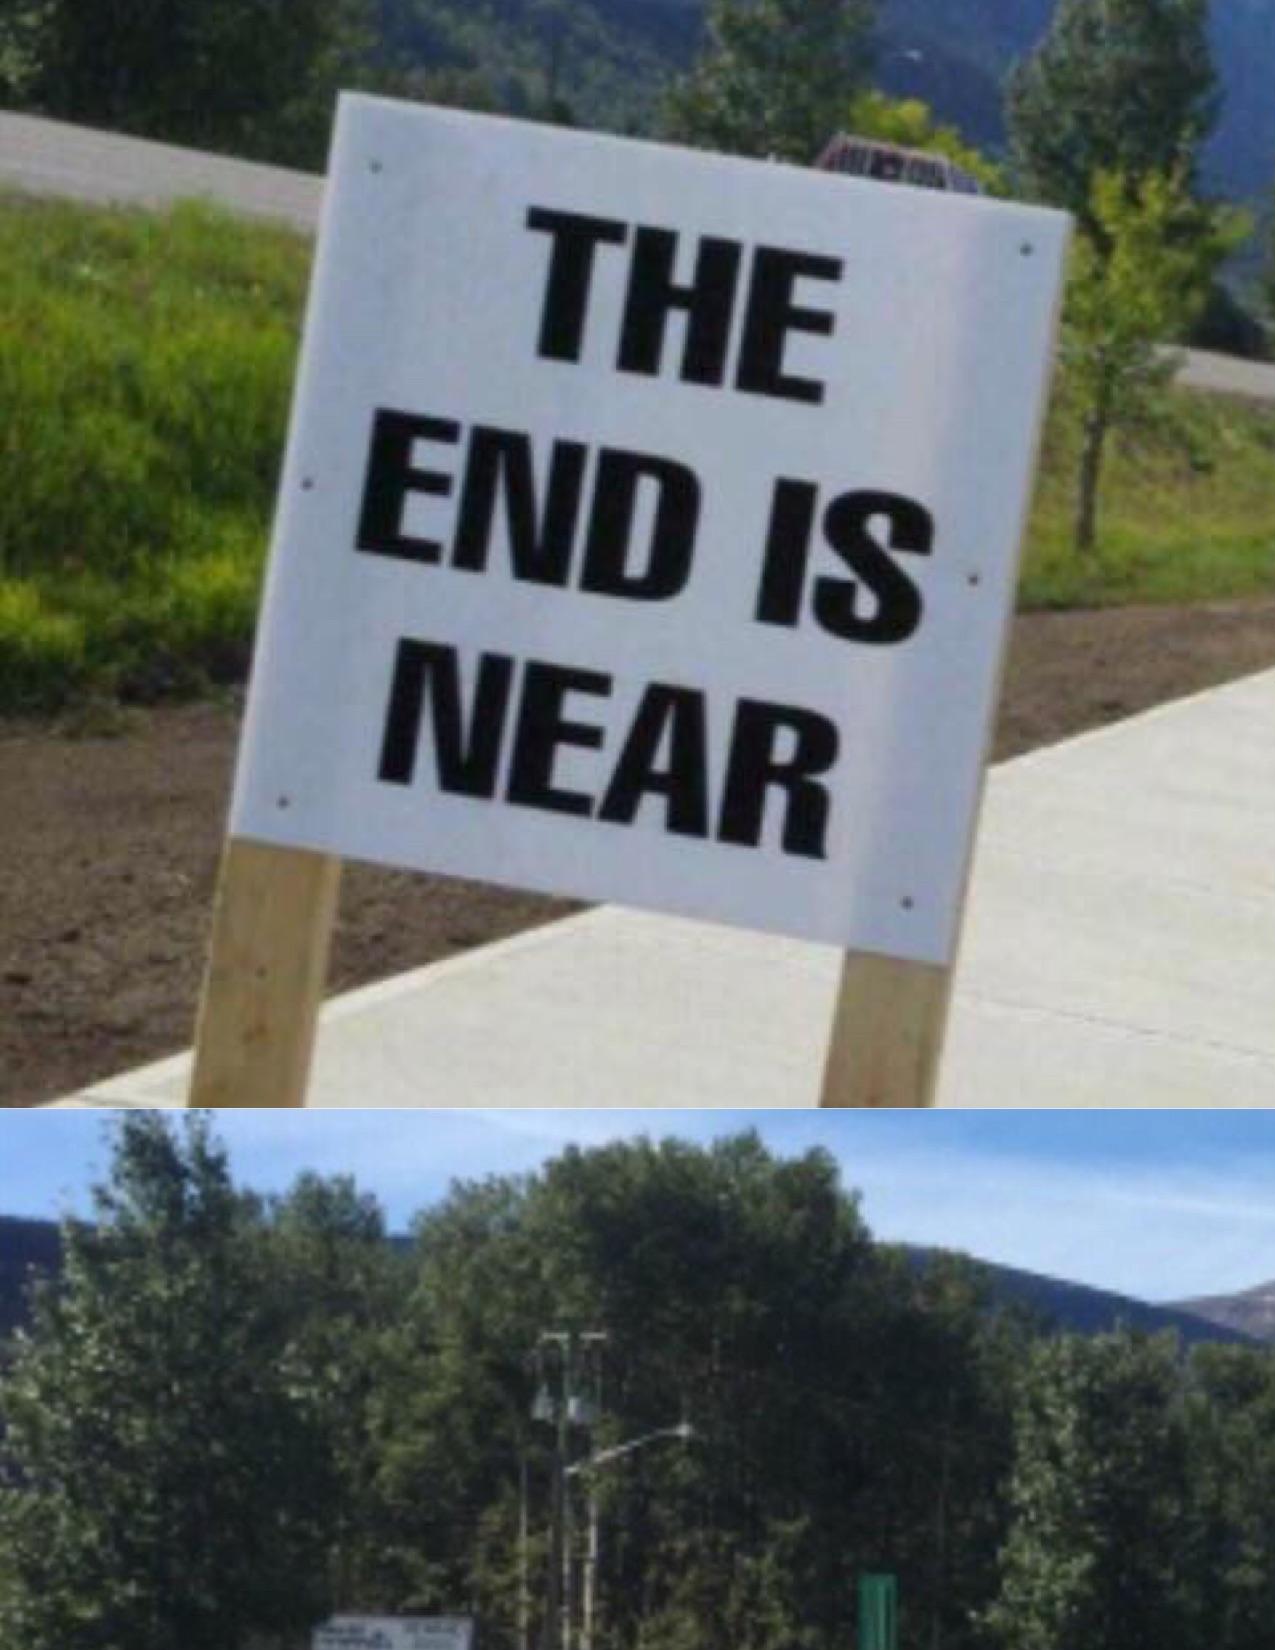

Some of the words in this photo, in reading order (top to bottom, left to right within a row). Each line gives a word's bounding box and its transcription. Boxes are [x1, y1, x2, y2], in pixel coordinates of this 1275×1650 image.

[526, 206, 844, 405] THE
[354, 407, 702, 602] END
[754, 477, 935, 644] IS
[376, 637, 840, 860] NEAR
